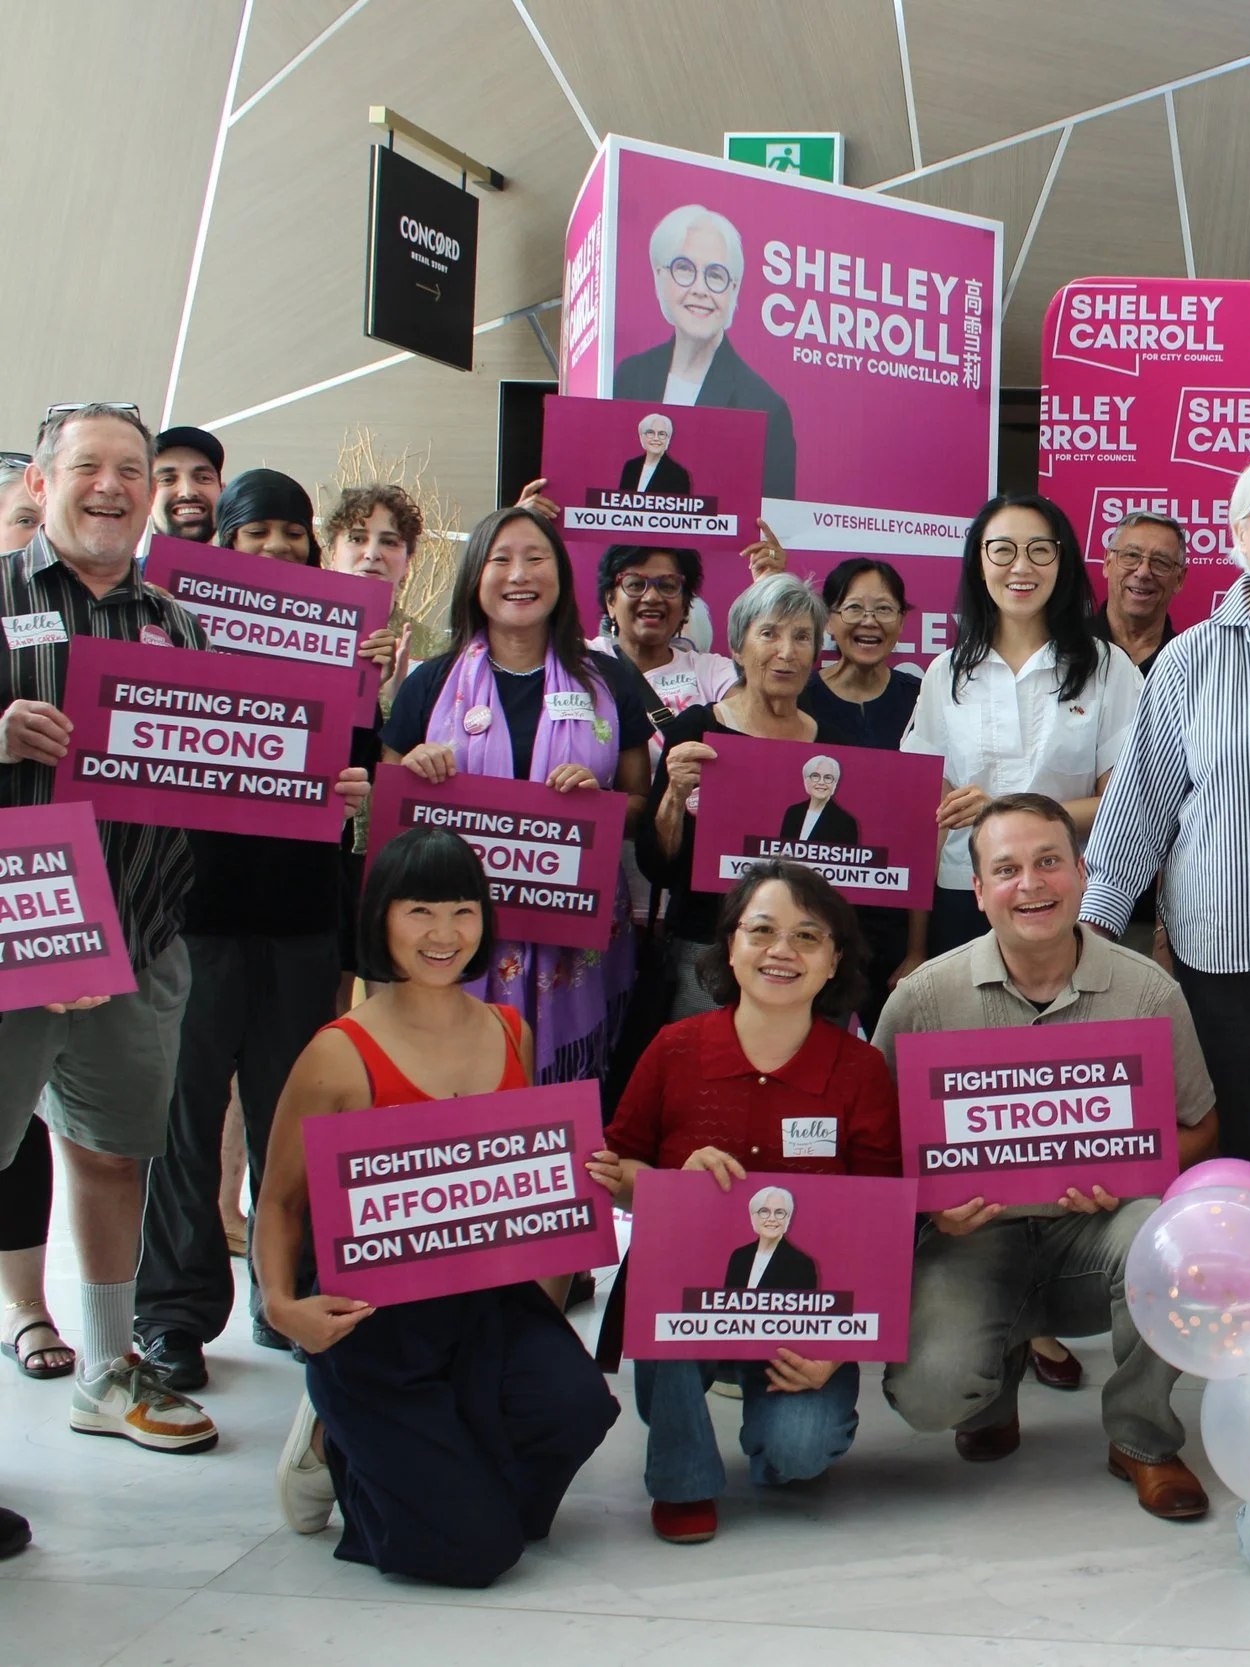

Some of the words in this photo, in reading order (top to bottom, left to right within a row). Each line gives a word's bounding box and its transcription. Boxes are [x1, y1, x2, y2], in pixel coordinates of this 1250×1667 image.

[762, 240, 959, 315] SHELLEY
[1070, 295, 1223, 321] SHELLEY
[761, 293, 960, 365] CARROLL
[962, 278, 983, 390] 高雪莉
[1069, 323, 1224, 350] CARROLL
[793, 346, 821, 365] FOR
[826, 352, 864, 371] CITY
[867, 359, 959, 387] COUNCILLOR
[1142, 353, 1158, 361] FOR
[1160, 353, 1182, 361] CITY
[1184, 354, 1223, 362] COUNCIL
[1055, 453, 1072, 461] FOR
[1074, 454, 1095, 462] CITY
[1097, 454, 1136, 462] COUNCIL
[600, 492, 704, 513] LEADERSHIP
[1101, 497, 1229, 524] SHELLE
[575, 512, 606, 526] YOU
[611, 514, 644, 528] CAN
[648, 516, 702, 530] COUNT
[706, 518, 729, 531] ON
[177, 576, 278, 612] FIGHTING
[281, 598, 322, 622] FOR
[329, 606, 357, 627] AN
[9, 615, 57, 632] hello
[196, 614, 350, 658] FFORDABLE
[659, 674, 693, 687] hello
[114, 683, 231, 715] FIGHTING
[238, 699, 284, 722] FOR
[291, 706, 308, 725] A
[552, 694, 590, 707] hello
[132, 720, 284, 761] STRONG
[82, 756, 138, 781] DON
[147, 763, 233, 791] VALLEY
[239, 771, 324, 800] NORTH
[412, 805, 513, 833] FIGHTING
[519, 818, 561, 841] FOR
[566, 825, 581, 843] A
[32, 850, 67, 873] AN
[759, 840, 872, 864] LEADERSHIP
[730, 861, 750, 878] YO
[875, 871, 899, 885] ON
[519, 889, 594, 912] NORTH
[13, 930, 101, 961] NORTH
[943, 1067, 1053, 1092] FIGHTING
[1060, 1064, 1105, 1084] FOR
[1112, 1062, 1128, 1081] A
[966, 1096, 1111, 1133] STRONG
[788, 1120, 832, 1138] hello
[349, 1143, 471, 1180] FIGHTING
[477, 1136, 525, 1161] FOR
[532, 1128, 566, 1152] AN
[926, 1147, 978, 1169] DON
[984, 1141, 1068, 1165] VALLEY
[1074, 1135, 1154, 1159] NORTH
[359, 1165, 568, 1226] AFFORDABLE
[343, 1236, 402, 1265] DON
[408, 1220, 499, 1254] VALLEY
[505, 1205, 589, 1239] NORTH
[701, 1291, 835, 1313] LEADERSHIP
[668, 1319, 707, 1336] YOU
[714, 1319, 755, 1336] CAN
[762, 1319, 832, 1335] COUNT
[838, 1319, 867, 1335] ON
